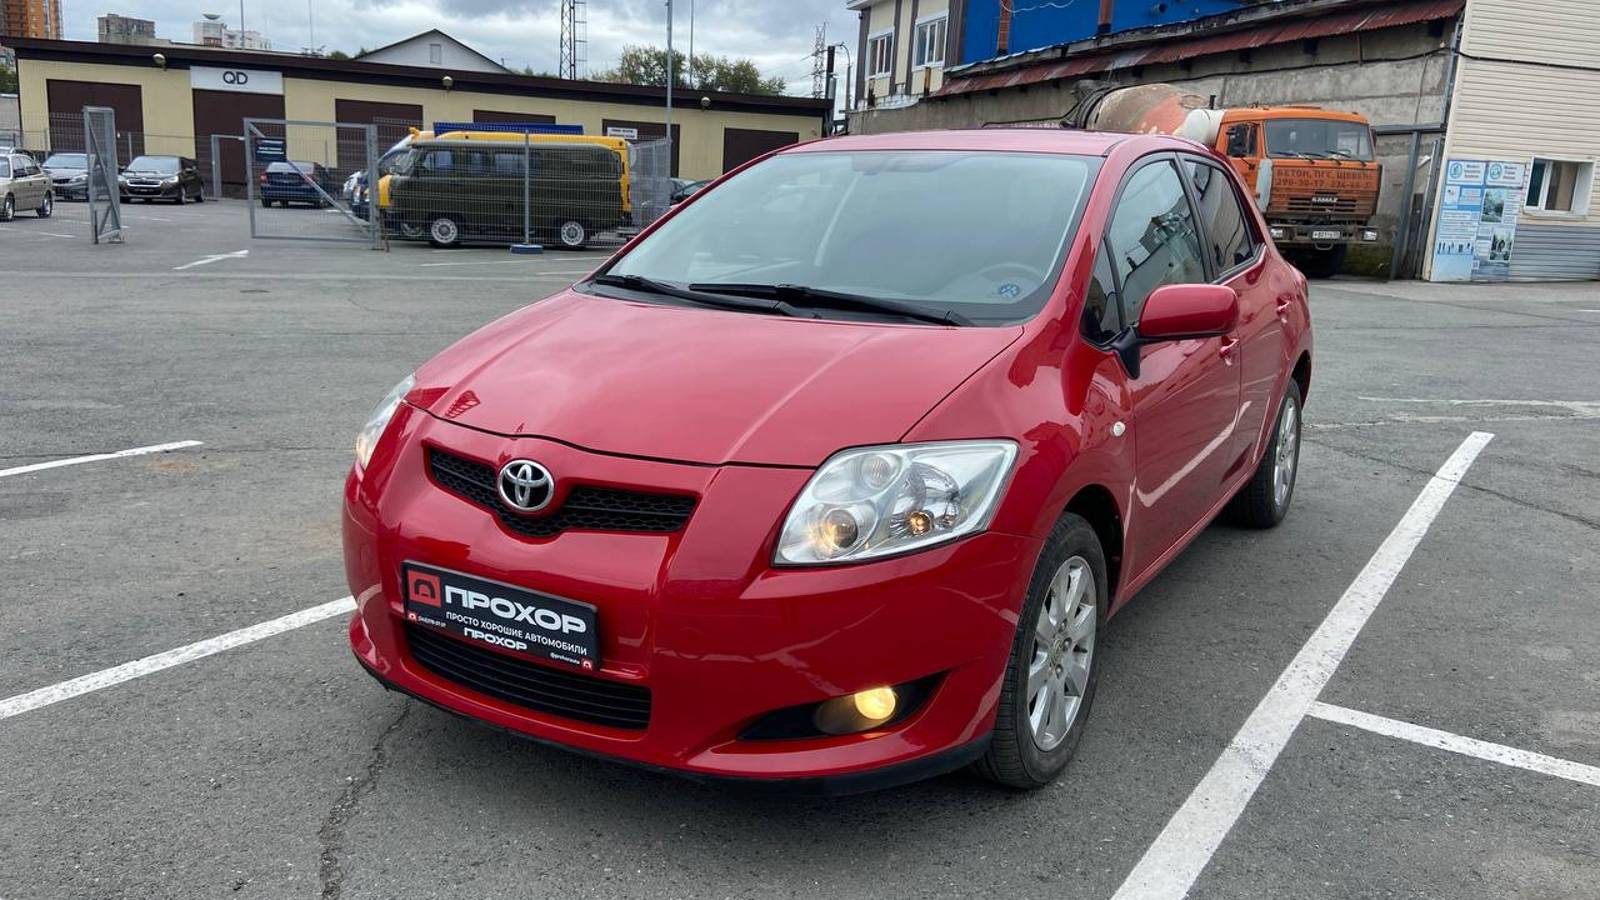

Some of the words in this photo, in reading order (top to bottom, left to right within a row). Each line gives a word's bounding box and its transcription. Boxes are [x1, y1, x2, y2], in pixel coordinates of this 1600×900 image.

[223, 71, 248, 85] QD
[445, 585, 587, 634] ПРОХОР
[446, 611, 479, 626] ПРОСТО
[480, 619, 524, 639] ХОРОШИЕ
[525, 632, 587, 656] АВТОМОБИЛИ
[464, 627, 528, 650] ПРОХОР
